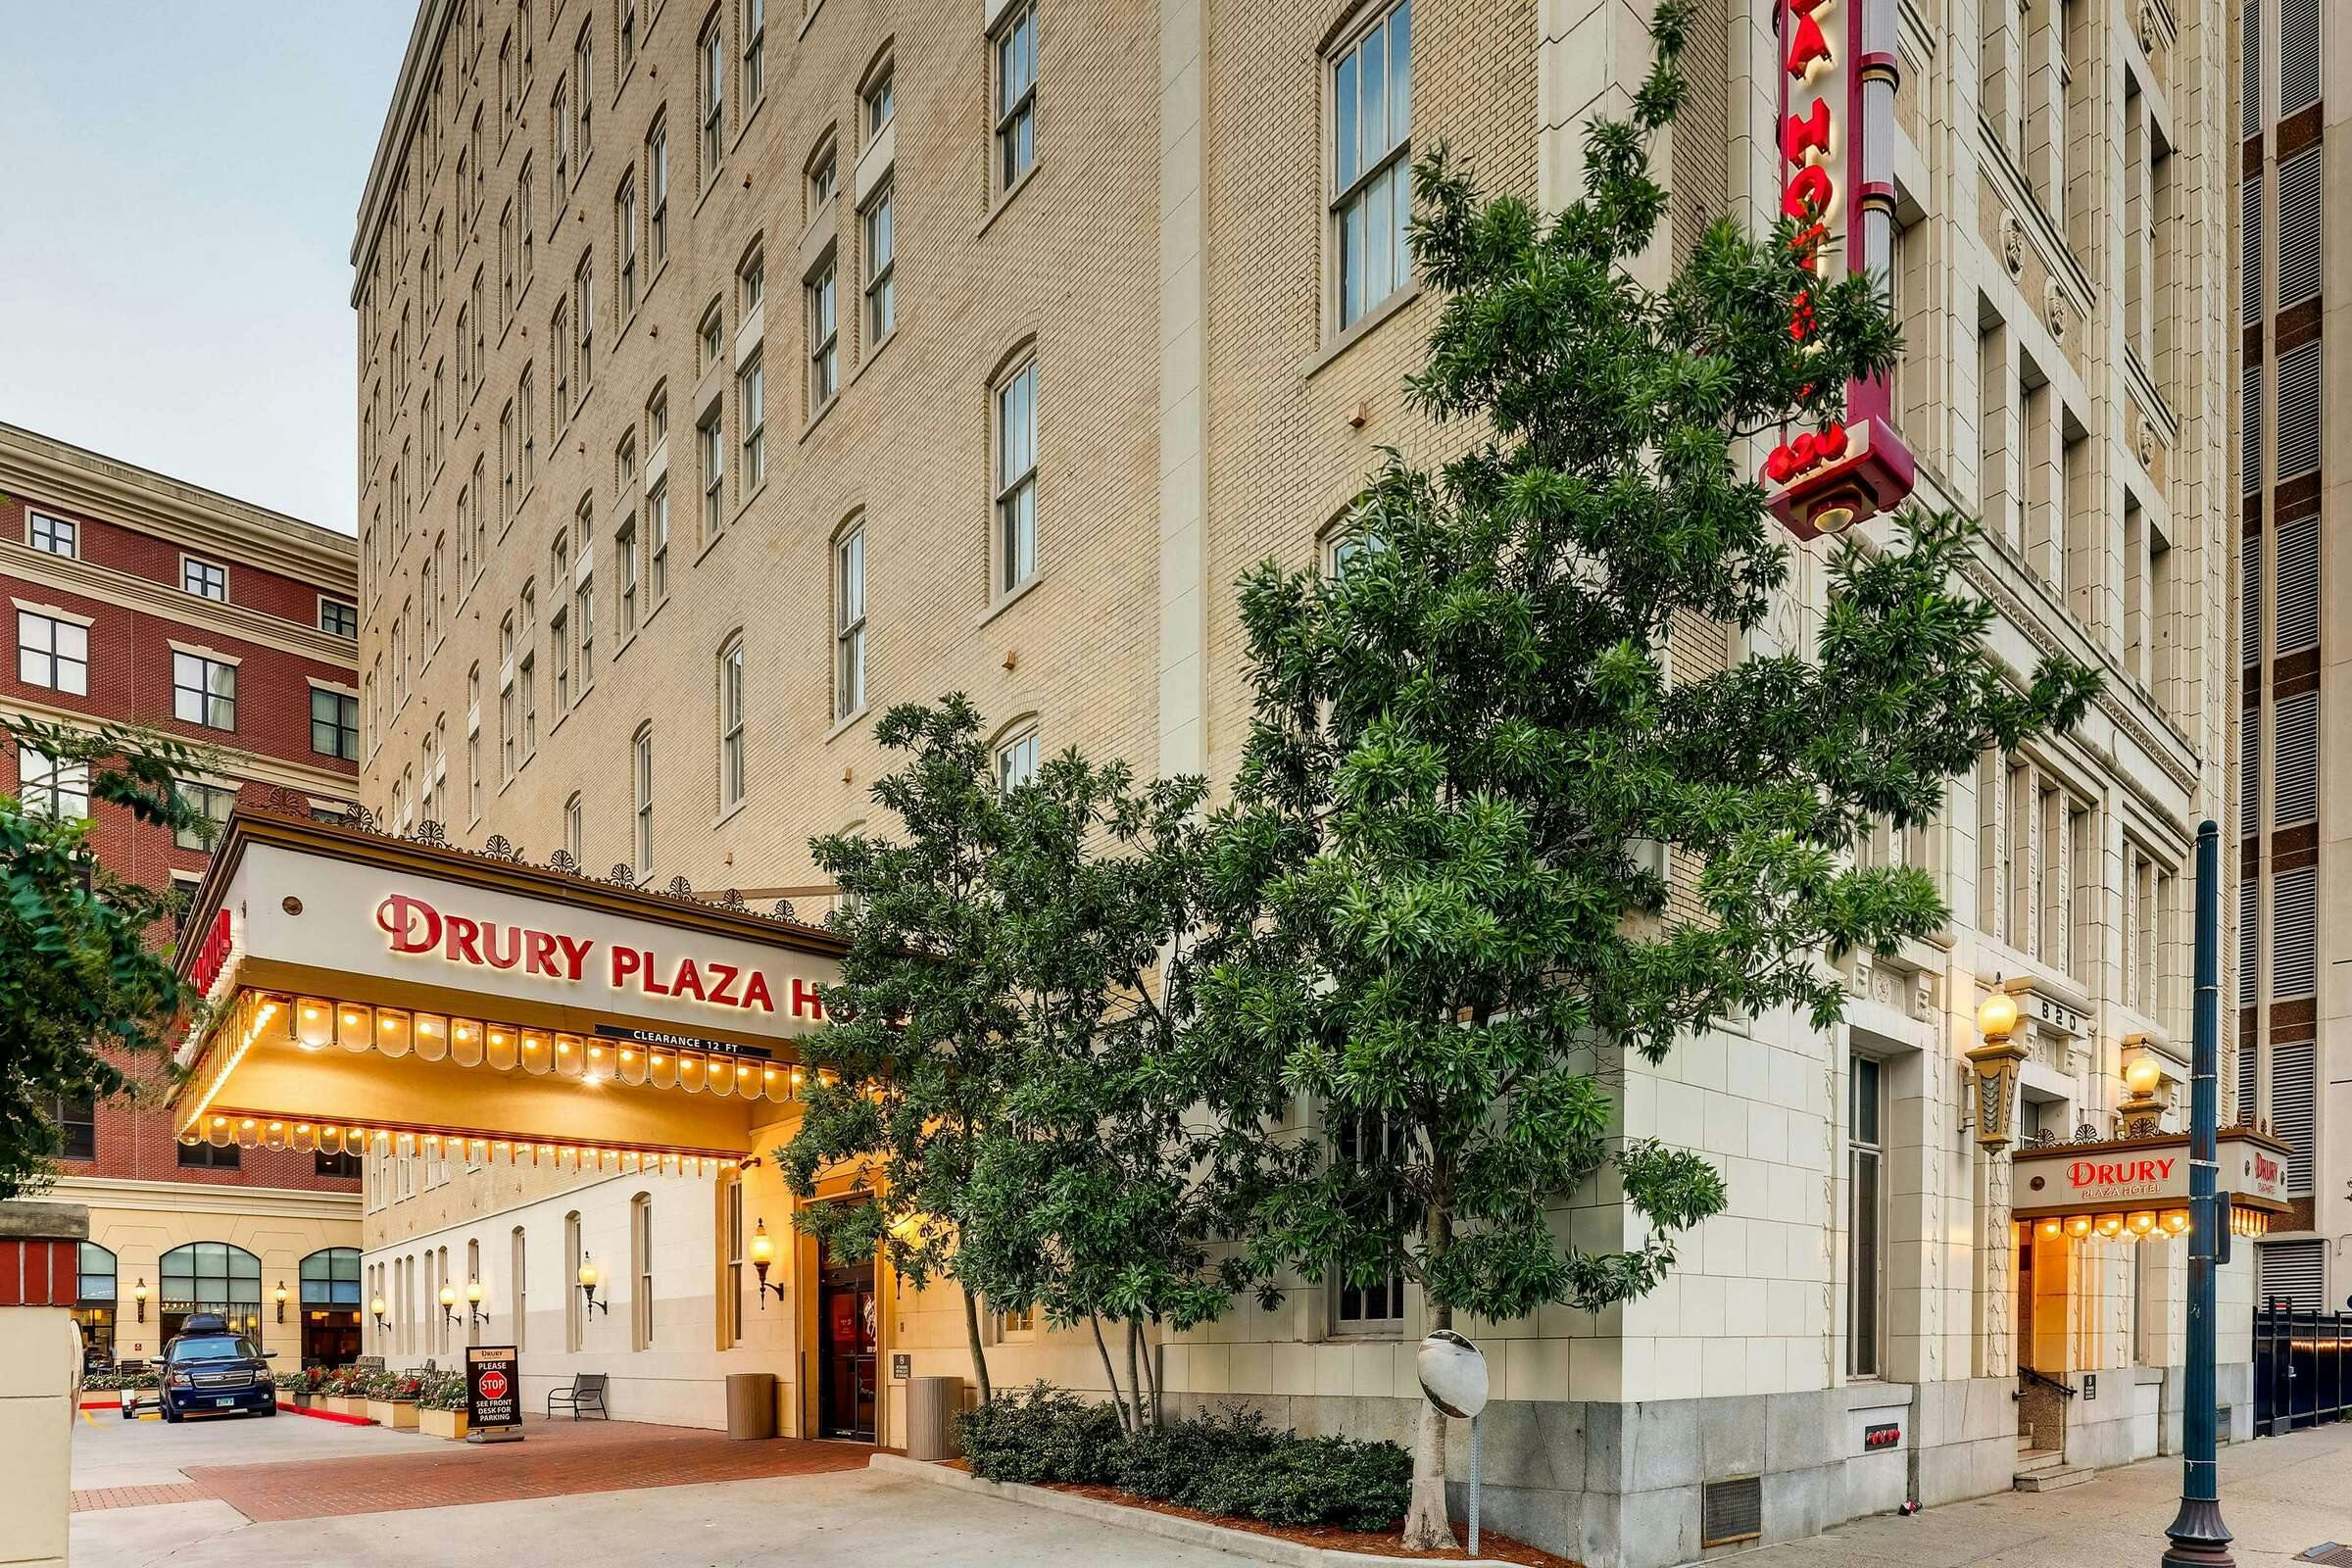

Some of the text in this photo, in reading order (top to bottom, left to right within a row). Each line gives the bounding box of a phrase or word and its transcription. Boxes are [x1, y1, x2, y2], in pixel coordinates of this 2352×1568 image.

[1767, 422, 1848, 485] 820
[376, 894, 594, 980] DRURY
[612, 946, 774, 1012] PLAZA
[2042, 1001, 2077, 1031] 820
[633, 1030, 738, 1053] CLEARANCE 12 FT
[2067, 1157, 2177, 1188] DRURY
[2082, 1183, 2163, 1199] PLAZA HOTEL
[481, 1380, 504, 1391] STOP
[479, 1413, 510, 1422] PARKING
